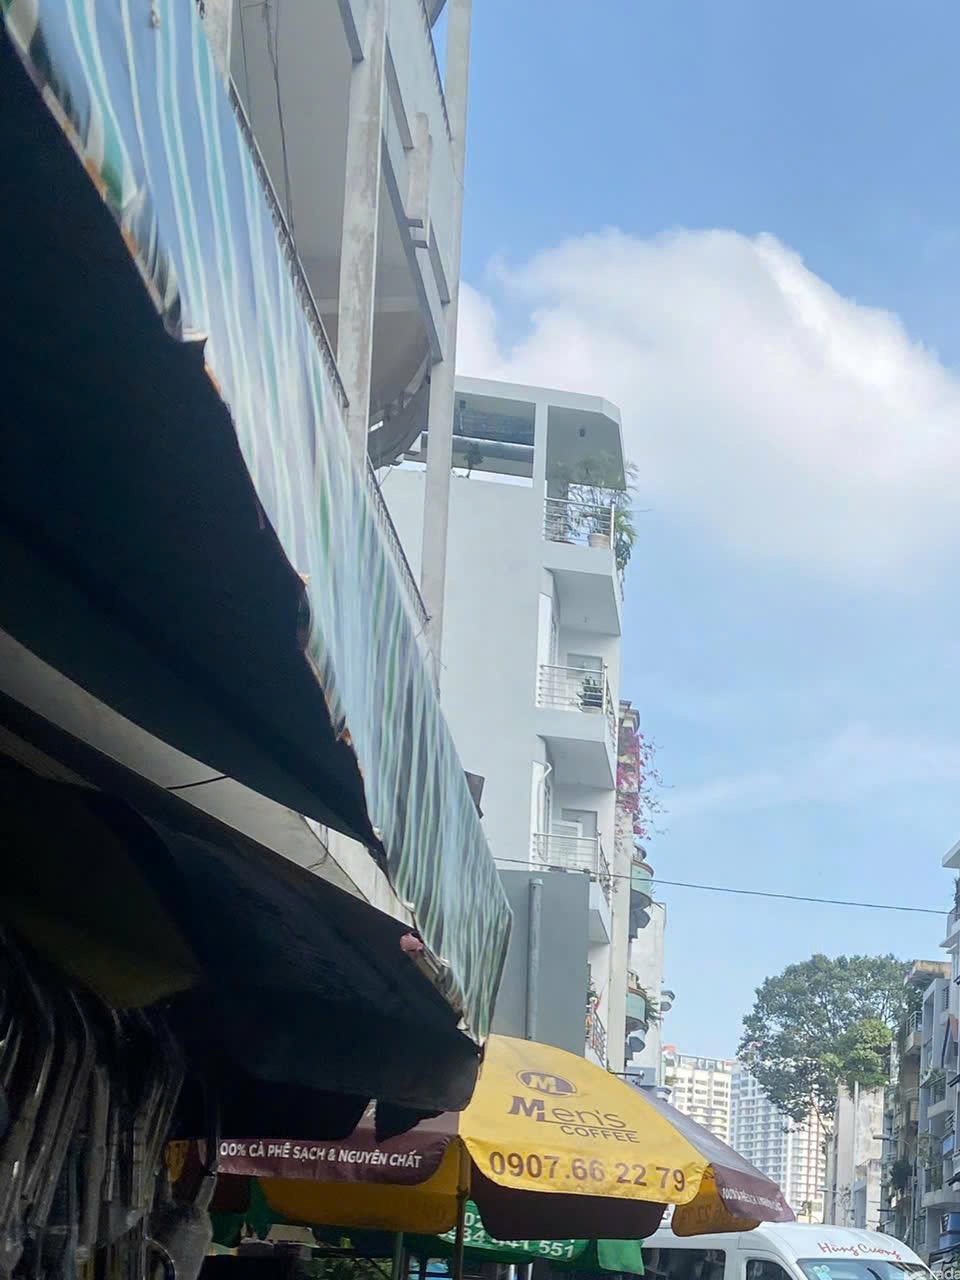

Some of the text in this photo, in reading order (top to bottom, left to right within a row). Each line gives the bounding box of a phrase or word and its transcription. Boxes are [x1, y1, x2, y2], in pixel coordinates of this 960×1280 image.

[508, 1096, 626, 1129] Men's
[560, 1125, 640, 1143] COFFEE
[220, 1140, 423, 1168] 00% CÀ PHÊ SẠCH & NGUYÊN CHẤT
[615, 1162, 648, 1187] 22
[656, 1166, 686, 1192] 79
